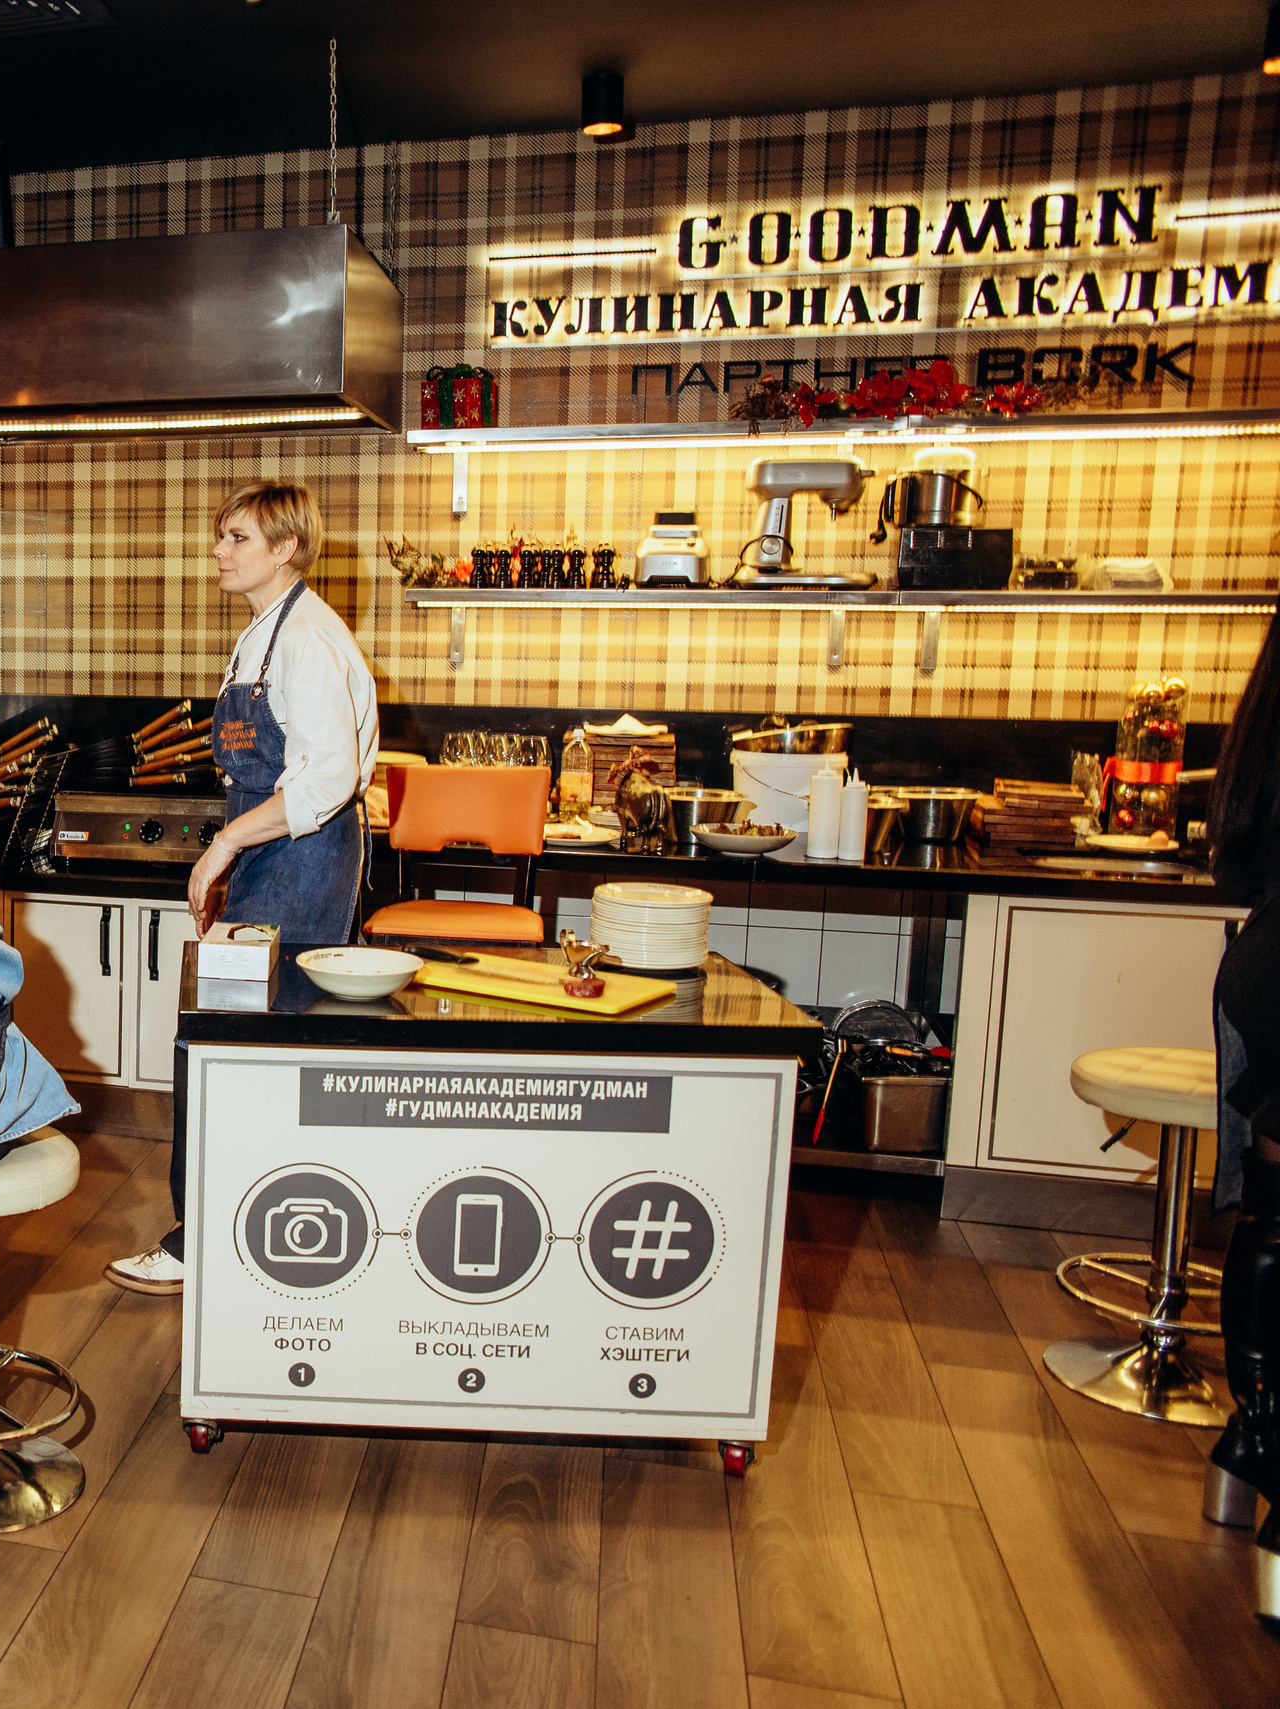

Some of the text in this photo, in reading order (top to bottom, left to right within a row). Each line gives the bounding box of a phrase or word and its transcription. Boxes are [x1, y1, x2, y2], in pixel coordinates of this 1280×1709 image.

[677, 184, 1163, 269] GOODMAN
[490, 258, 1278, 339] КУЛИНАРНАЯ АКАДЕМ
[322, 1073, 649, 1099] #КУЛИНАРНАЯАКАДЕМИЯГУДМАН
[384, 1097, 583, 1122] #ГУДМАНАКАДЕМИЯ
[262, 1315, 344, 1332] ДЕЛАЕМ
[398, 1319, 550, 1338] ВЫКЛАДЫВАЕМ
[605, 1325, 685, 1342] СТАВИМ
[273, 1337, 332, 1352] ФОТО
[415, 1341, 531, 1359] В СОЦ. СЕТИ
[599, 1346, 690, 1363] ХЭШТЕГИ
[297, 1366, 306, 1382] 1
[465, 1372, 478, 1388] 2
[636, 1377, 649, 1393] 3
